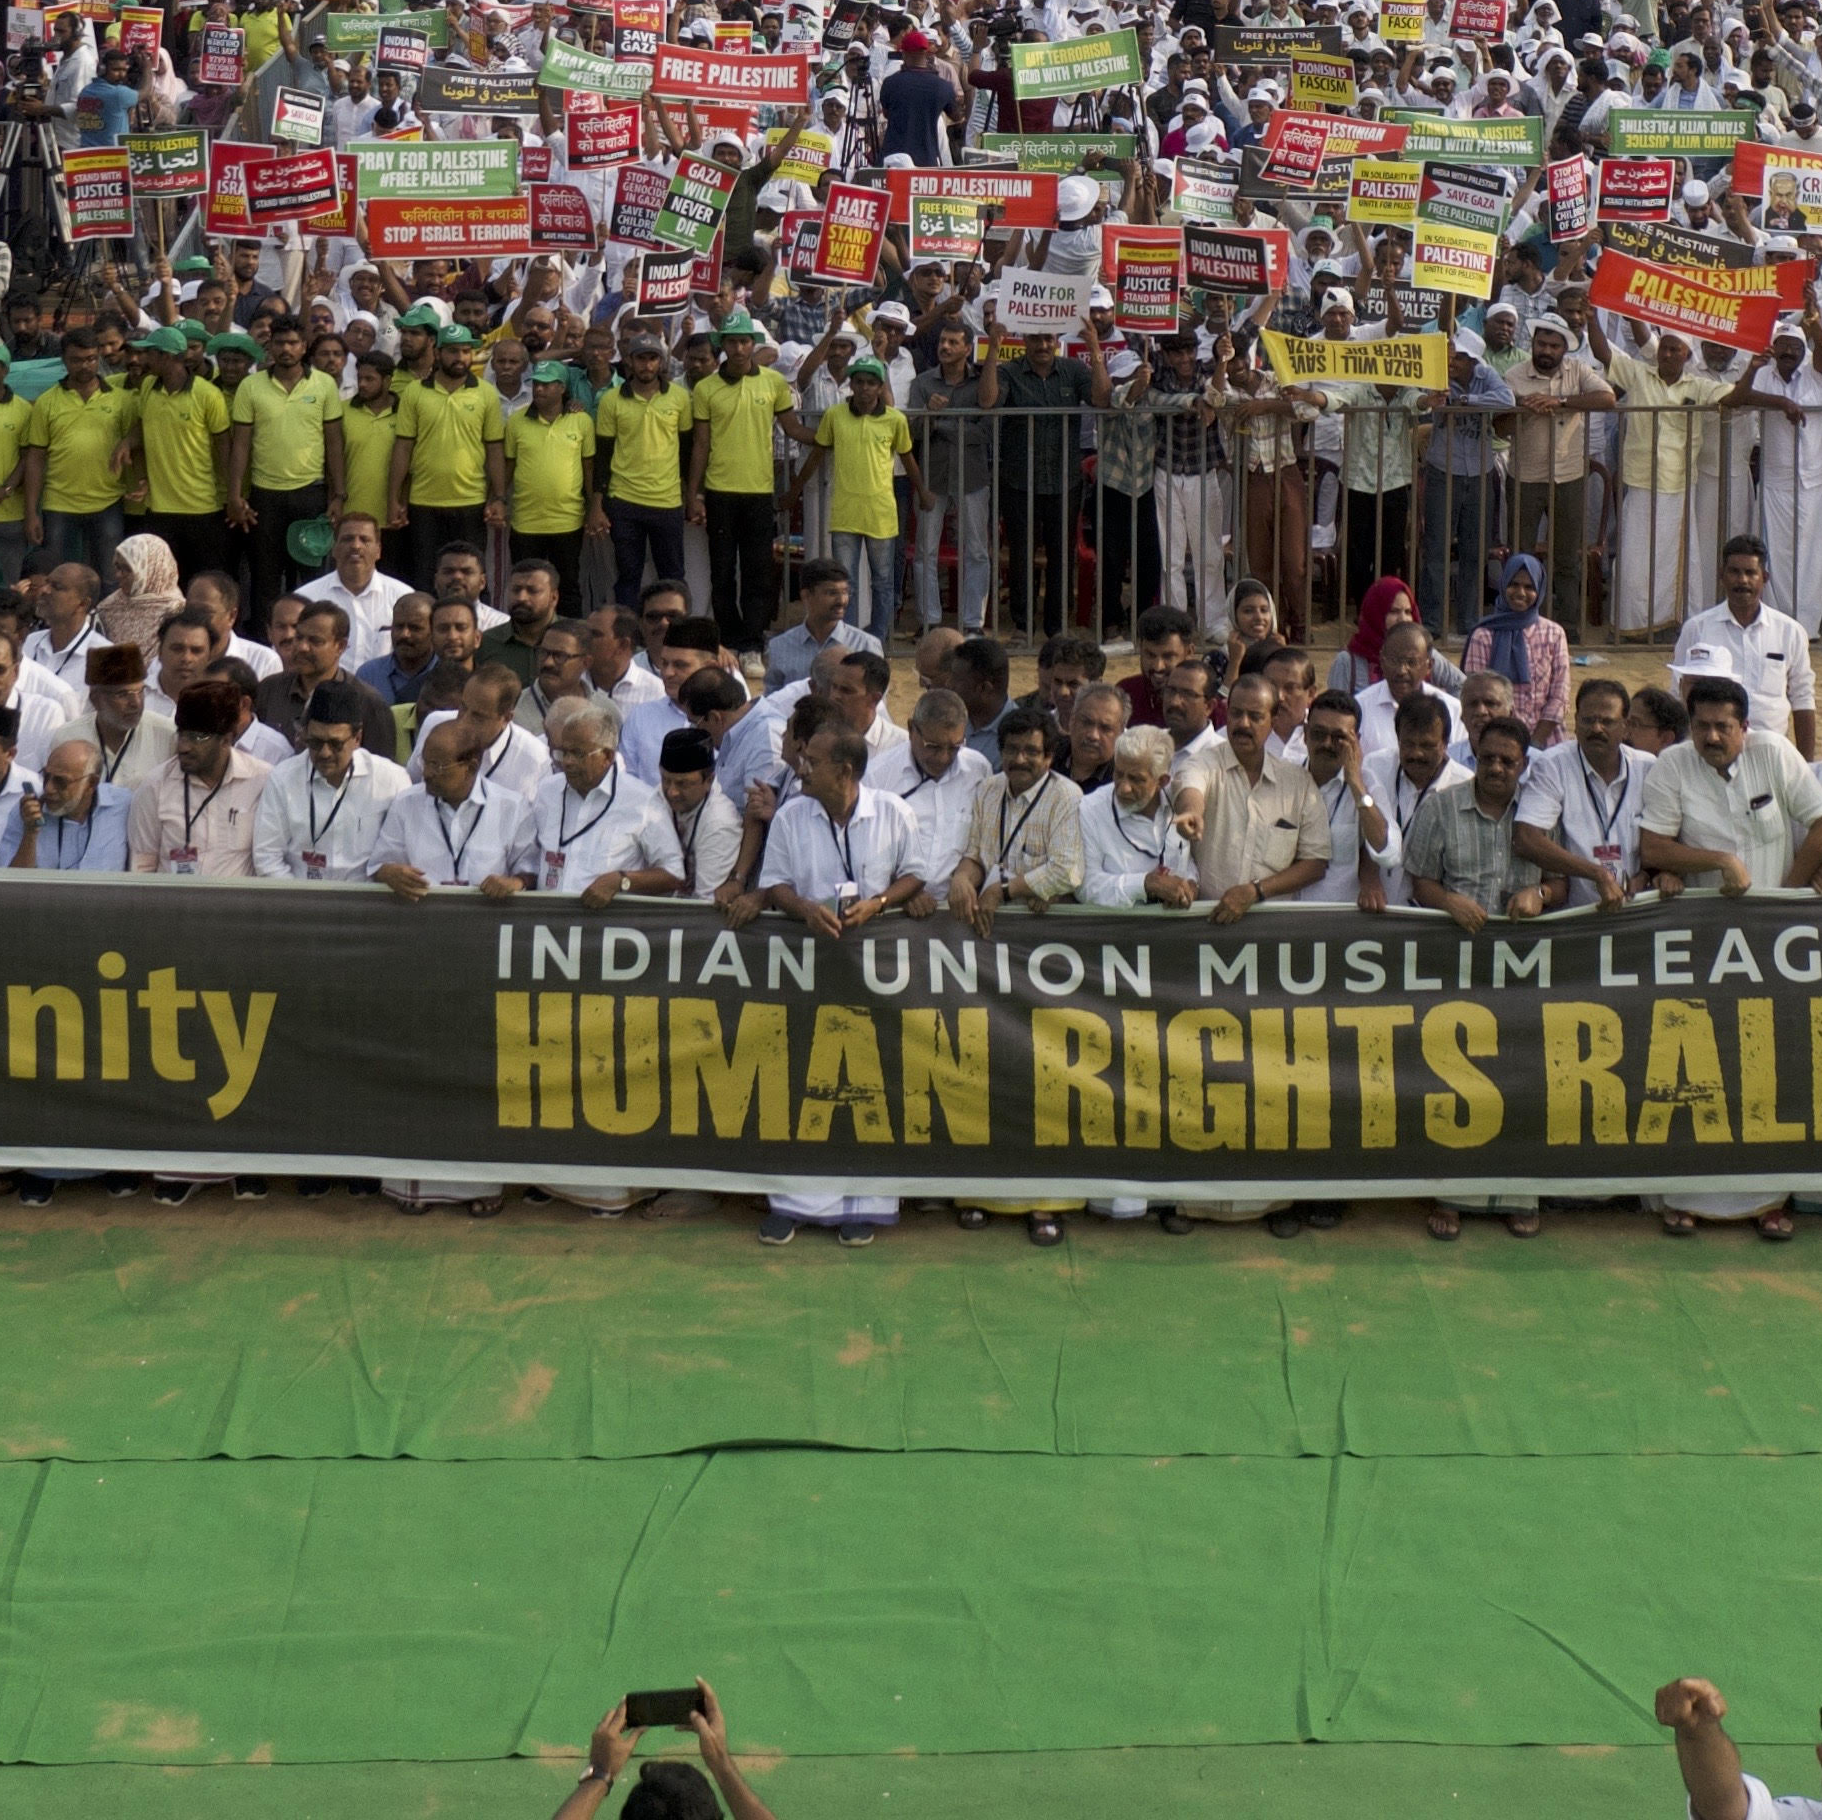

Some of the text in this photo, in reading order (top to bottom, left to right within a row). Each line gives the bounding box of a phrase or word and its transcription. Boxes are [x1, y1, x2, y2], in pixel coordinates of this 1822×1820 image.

[623, 30, 656, 43] SAVE
[550, 49, 612, 72] PRAY FOR
[1048, 41, 1111, 64] TERRORISM
[661, 58, 798, 88] FREE PALESTINE
[1043, 64, 1069, 83] WITH
[1073, 56, 1130, 80] PALESTINE
[1300, 76, 1347, 93] FASCISM
[358, 149, 508, 170] PRAY FOR PALESTINE
[380, 171, 485, 187] #FREE PALESTINE
[688, 163, 722, 187] GAZA
[75, 183, 123, 199] JUSTICE
[684, 181, 713, 204] WILL
[910, 176, 1031, 197] END PALESTINIAN
[836, 196, 878, 217] HATE
[1447, 188, 1495, 209] SAVE GAZA
[671, 200, 714, 222] NEVER
[1428, 203, 1496, 228] FREE PALESTINE
[677, 220, 699, 238] DIE
[828, 224, 871, 245] STAND
[830, 241, 865, 260] WITH
[1191, 240, 1257, 263] INDIA WITH
[1656, 229, 1720, 256] PALESTINE
[1192, 256, 1258, 280] PALESTINE
[1423, 247, 1487, 271] PALESTINE
[1013, 282, 1075, 301] PRAY FOR
[1124, 277, 1171, 292] JUSTICE
[1629, 270, 1743, 322] PALESTINE
[1008, 301, 1077, 317] PALESTINE
[1123, 303, 1170, 315] PALESTINE
[1625, 292, 1737, 333] WILL NEVER WALK ALONE
[1289, 356, 1326, 374] SAVE
[1341, 356, 1423, 379] GAZA WILL
[498, 924, 815, 991] INDIAN
[863, 938, 1151, 998] UNION
[1199, 939, 1551, 997] MUSLIM
[495, 990, 989, 1146] HUMAN
[1031, 1000, 1504, 1151] RIGHTS
